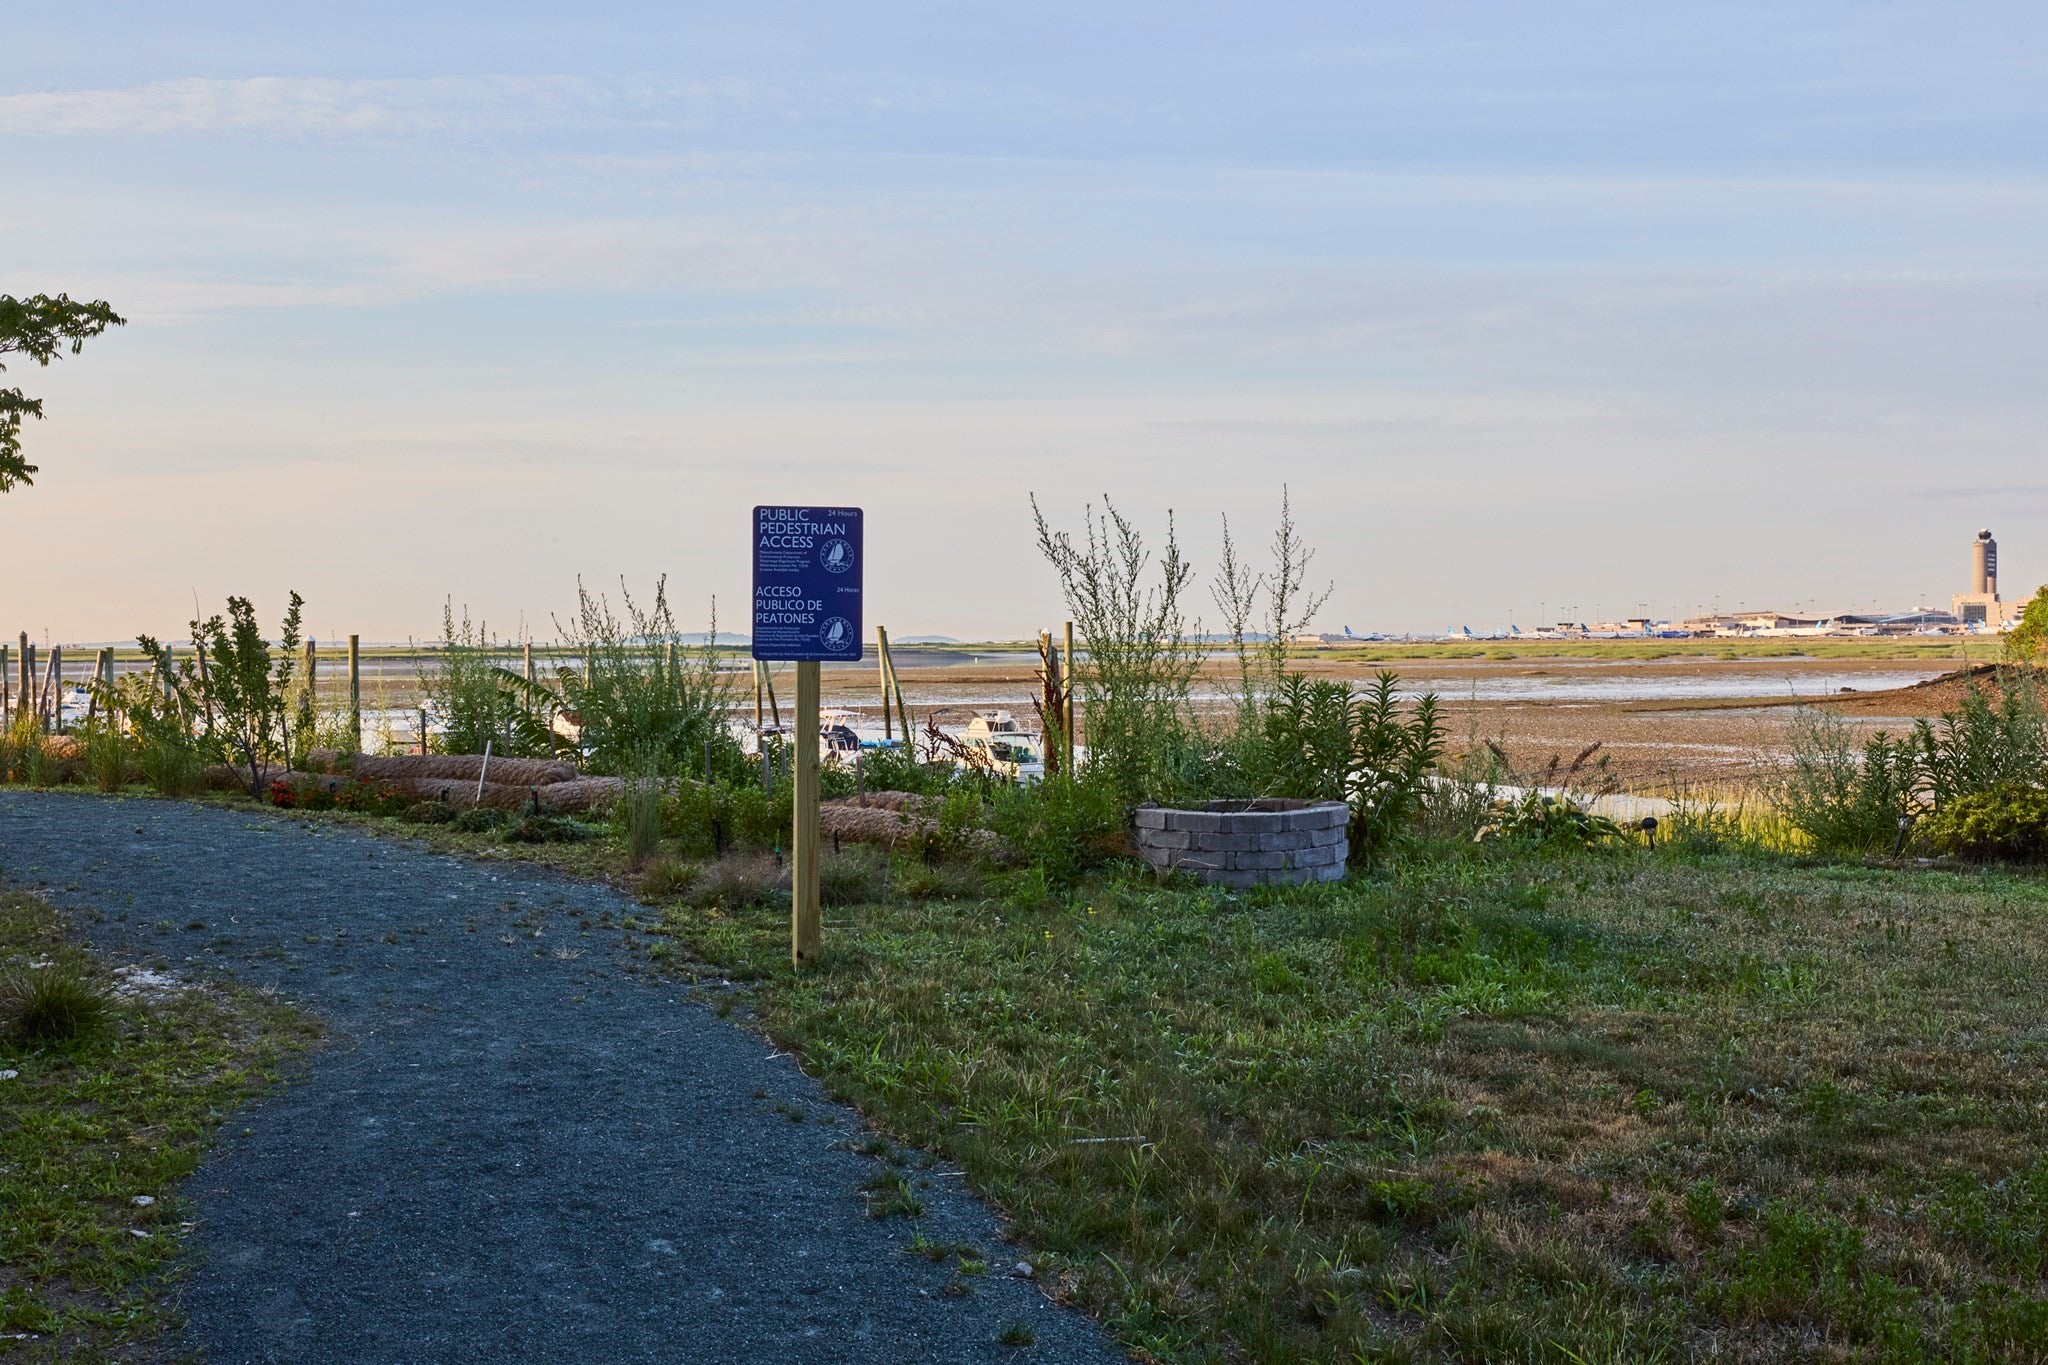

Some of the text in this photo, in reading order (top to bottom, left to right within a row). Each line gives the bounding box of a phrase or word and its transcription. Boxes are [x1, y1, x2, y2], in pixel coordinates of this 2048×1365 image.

[760, 509, 809, 521] PUBLIC
[760, 522, 846, 535] PEDESTRIAN
[760, 536, 814, 548] ACCESS
[756, 586, 802, 597] ACCESO
[756, 600, 822, 610] PUBLICO DE
[756, 613, 815, 624] PEATONES
